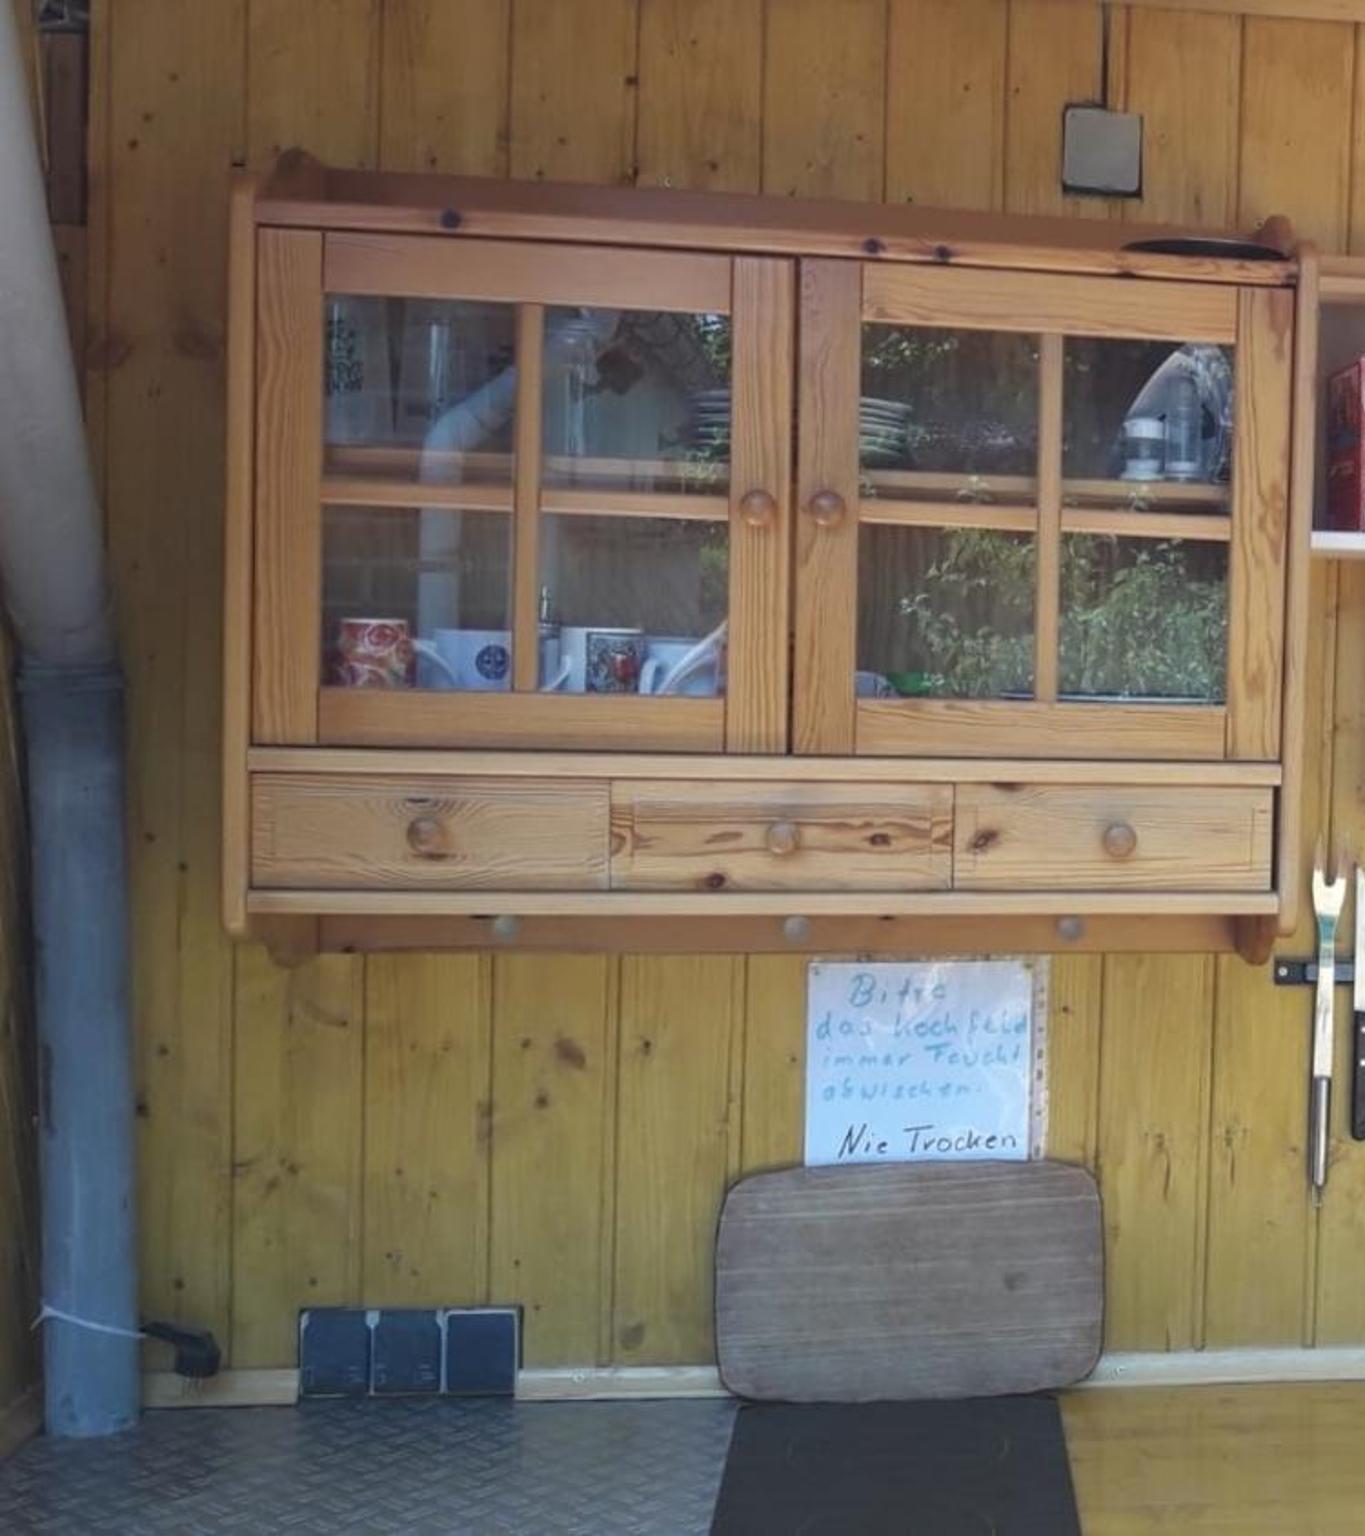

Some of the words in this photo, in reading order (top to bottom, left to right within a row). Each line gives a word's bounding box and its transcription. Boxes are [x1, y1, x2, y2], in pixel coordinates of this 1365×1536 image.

[815, 1012, 873, 1041] das
[822, 1048, 913, 1069] immer
[924, 1041, 1021, 1068] Feucht
[837, 1124, 889, 1159] Nie
[903, 1125, 1017, 1153] Trocken
